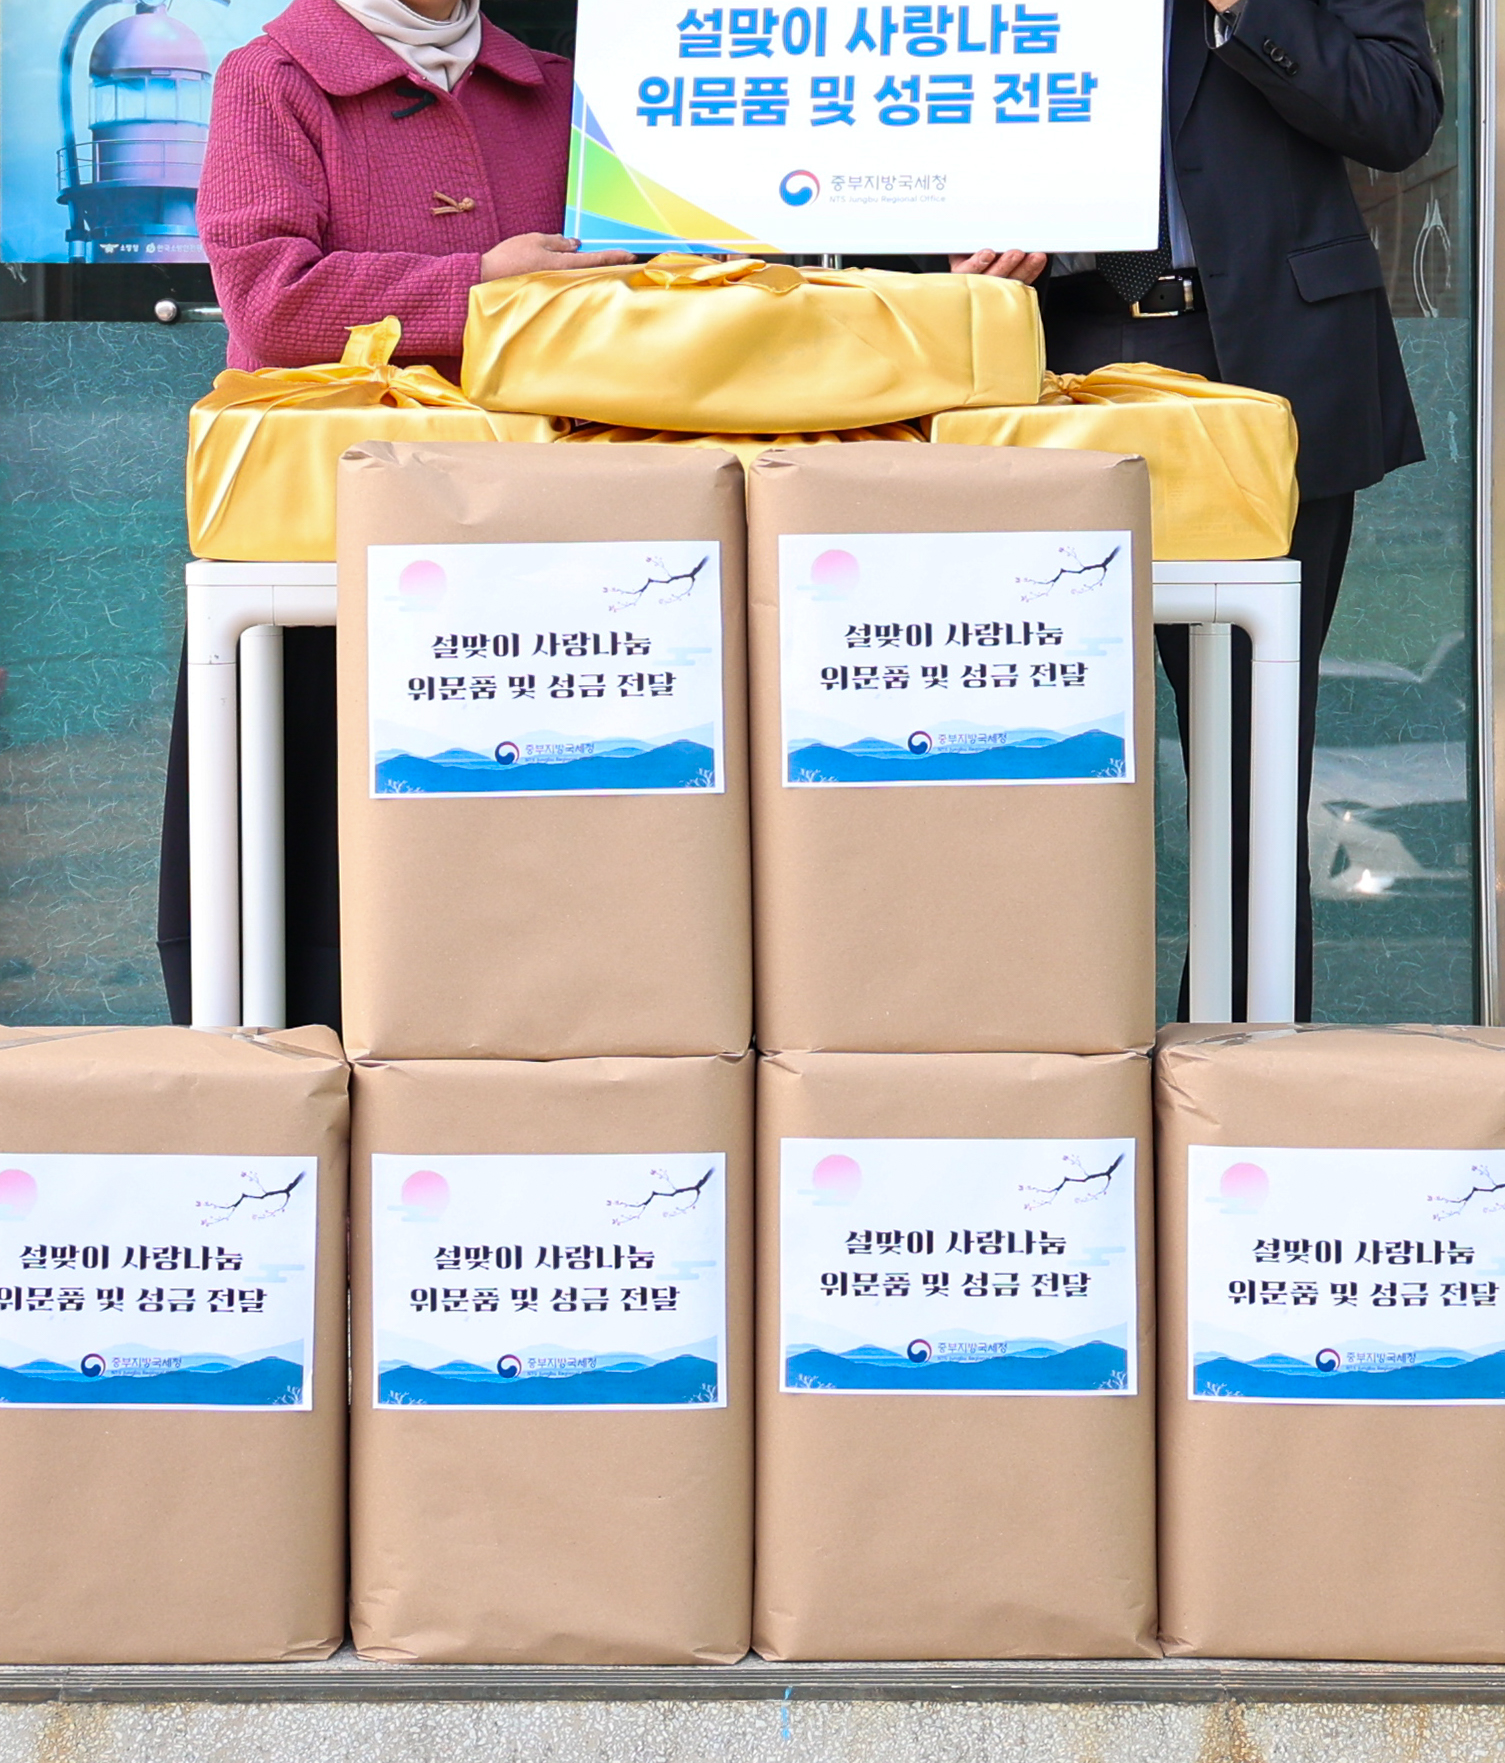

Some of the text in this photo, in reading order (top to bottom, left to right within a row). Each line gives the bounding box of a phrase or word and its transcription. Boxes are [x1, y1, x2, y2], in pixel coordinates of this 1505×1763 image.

[676, 3, 1061, 59] 설맞이 사랑나눔
[636, 70, 1098, 128] 위문품 및 성금 전달
[831, 174, 946, 191] 중부지방국세청
[431, 631, 651, 659] 설맞이 사랑나눔
[844, 621, 1064, 648] 설맞이 사랑나눔
[407, 671, 677, 701] 위문품 및 성금 전달
[820, 661, 1088, 691] 위문품 및 성금 전달
[845, 1229, 1066, 1255] 설맞이 사랑나눔
[1252, 1238, 1475, 1265] 설맞이 사랑나눔
[19, 1244, 243, 1271] 설맞이 사랑나눔
[434, 1244, 655, 1270] 설맞이 사랑나눔
[820, 1271, 1091, 1297] 위문품 및 성금 전달
[1228, 1279, 1499, 1307] 위문품 및 성금 전달
[96, 1286, 124, 1313] 및
[135, 1287, 196, 1313] 성금
[206, 1287, 267, 1314] 전달
[409, 1286, 680, 1313] 위문품 및 성금 전달
